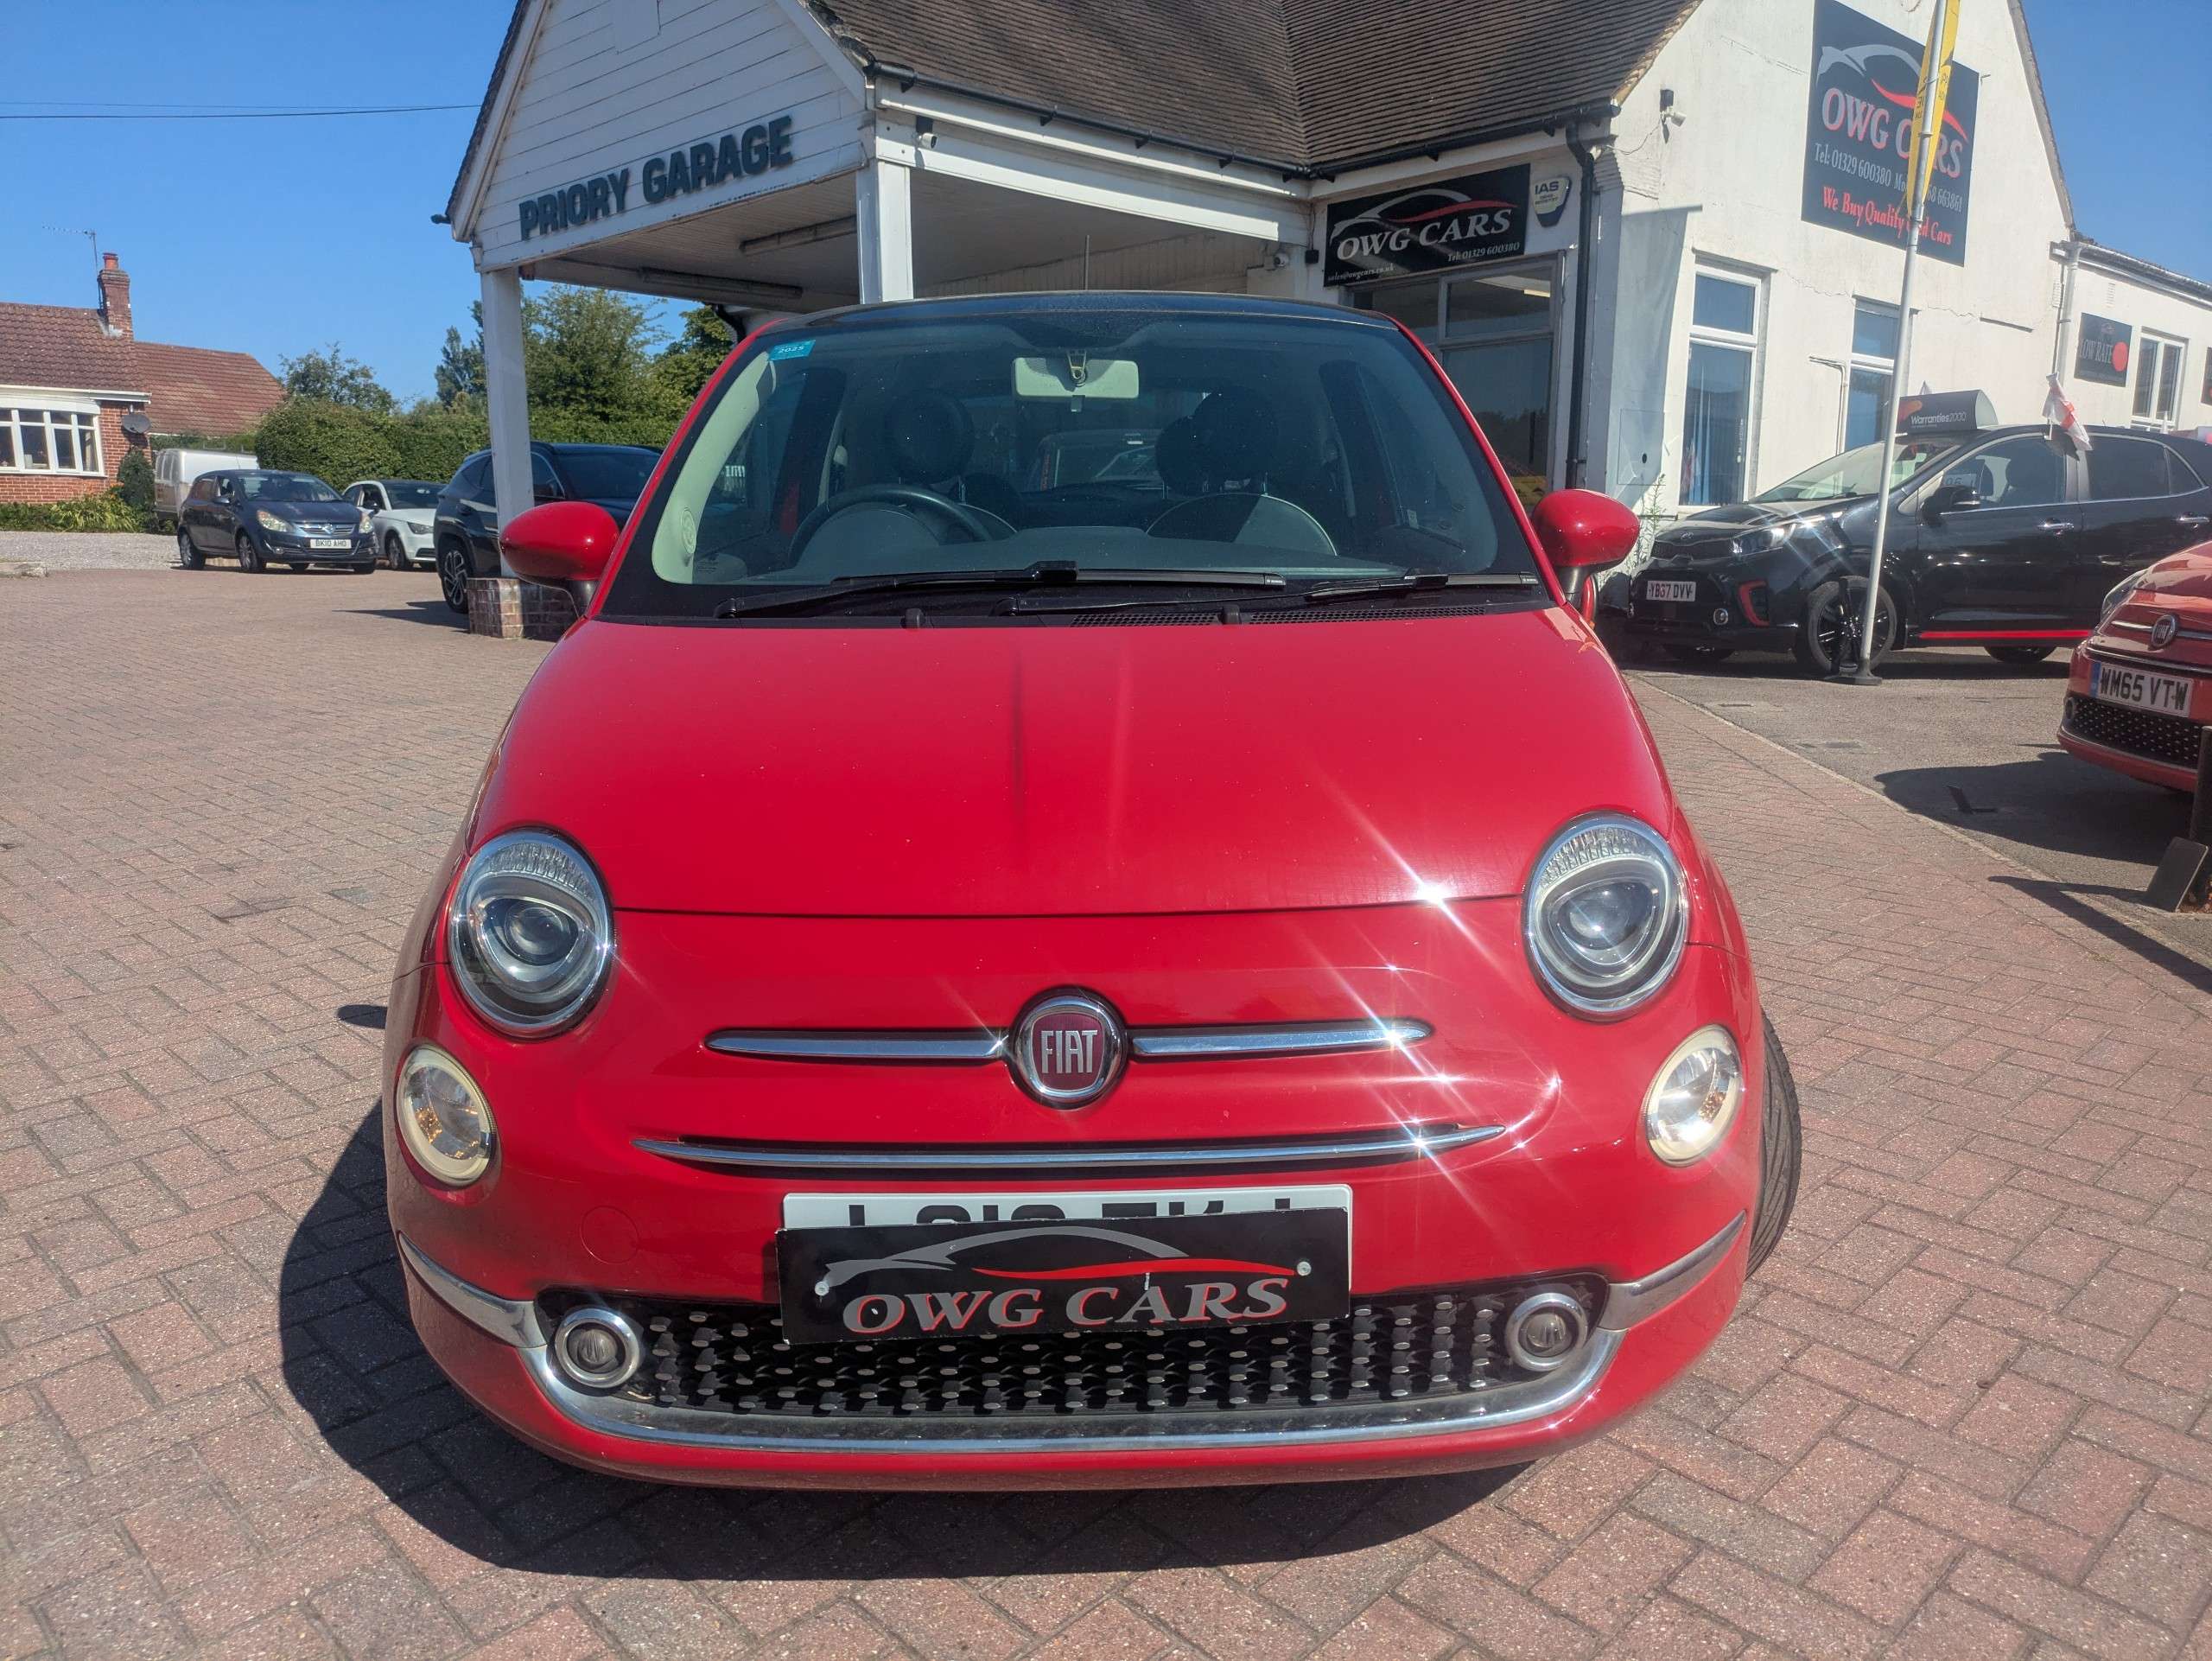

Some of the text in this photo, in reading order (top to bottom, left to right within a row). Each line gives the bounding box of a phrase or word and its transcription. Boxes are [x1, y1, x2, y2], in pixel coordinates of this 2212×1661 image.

[1821, 87, 1963, 179] OWG CRS
[518, 115, 793, 241] PRIORY GARAGE
[1535, 181, 1559, 194] IAS
[1831, 150, 1858, 175] 01329
[1858, 160, 1891, 187] 600380
[1337, 208, 1512, 260] OWG CARS
[1823, 186, 1839, 211] We
[1842, 192, 1866, 227] Buy
[1866, 200, 1904, 239] Quality
[1930, 221, 1953, 245] Cars
[2100, 667, 2189, 711] WM65 VTW
[1040, 1029, 1098, 1074] FIAT
[842, 1276, 1288, 1334] OWG CARS
